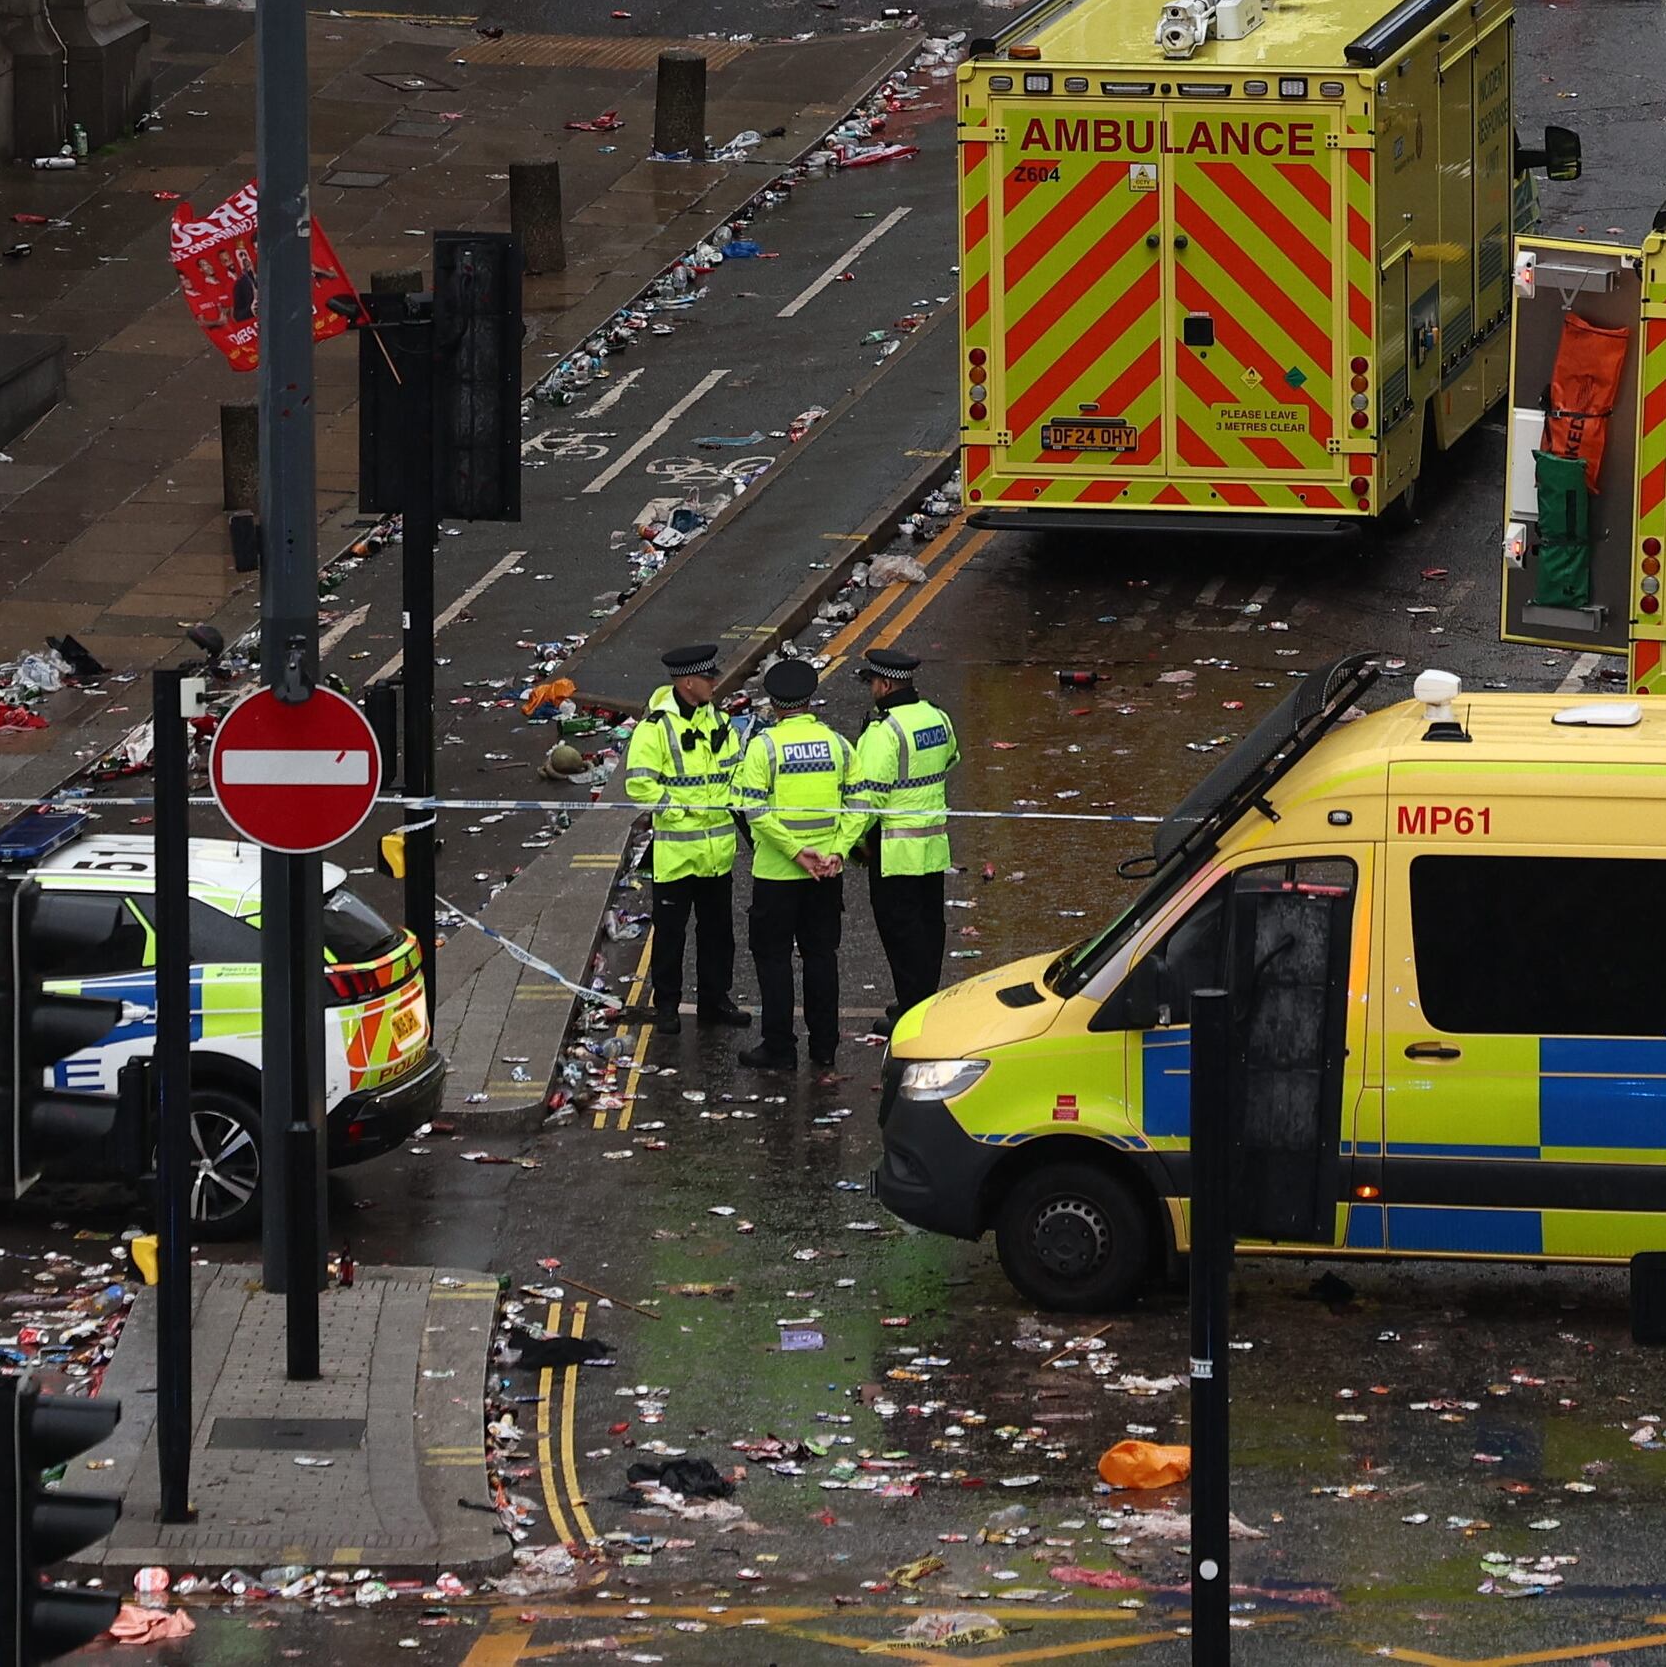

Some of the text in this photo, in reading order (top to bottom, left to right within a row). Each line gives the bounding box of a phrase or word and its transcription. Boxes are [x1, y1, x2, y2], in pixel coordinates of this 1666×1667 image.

[1020, 117, 1315, 156] AMBULANCE
[1014, 166, 1060, 183] Z604
[1221, 410, 1298, 420] PLEASE LEAVE
[1053, 427, 1134, 445] DF24 OHY
[1216, 422, 1305, 433] 3 METRES CLEAR
[916, 727, 948, 749] POLICE
[784, 742, 830, 762] POLICE
[1397, 805, 1491, 836] MP61
